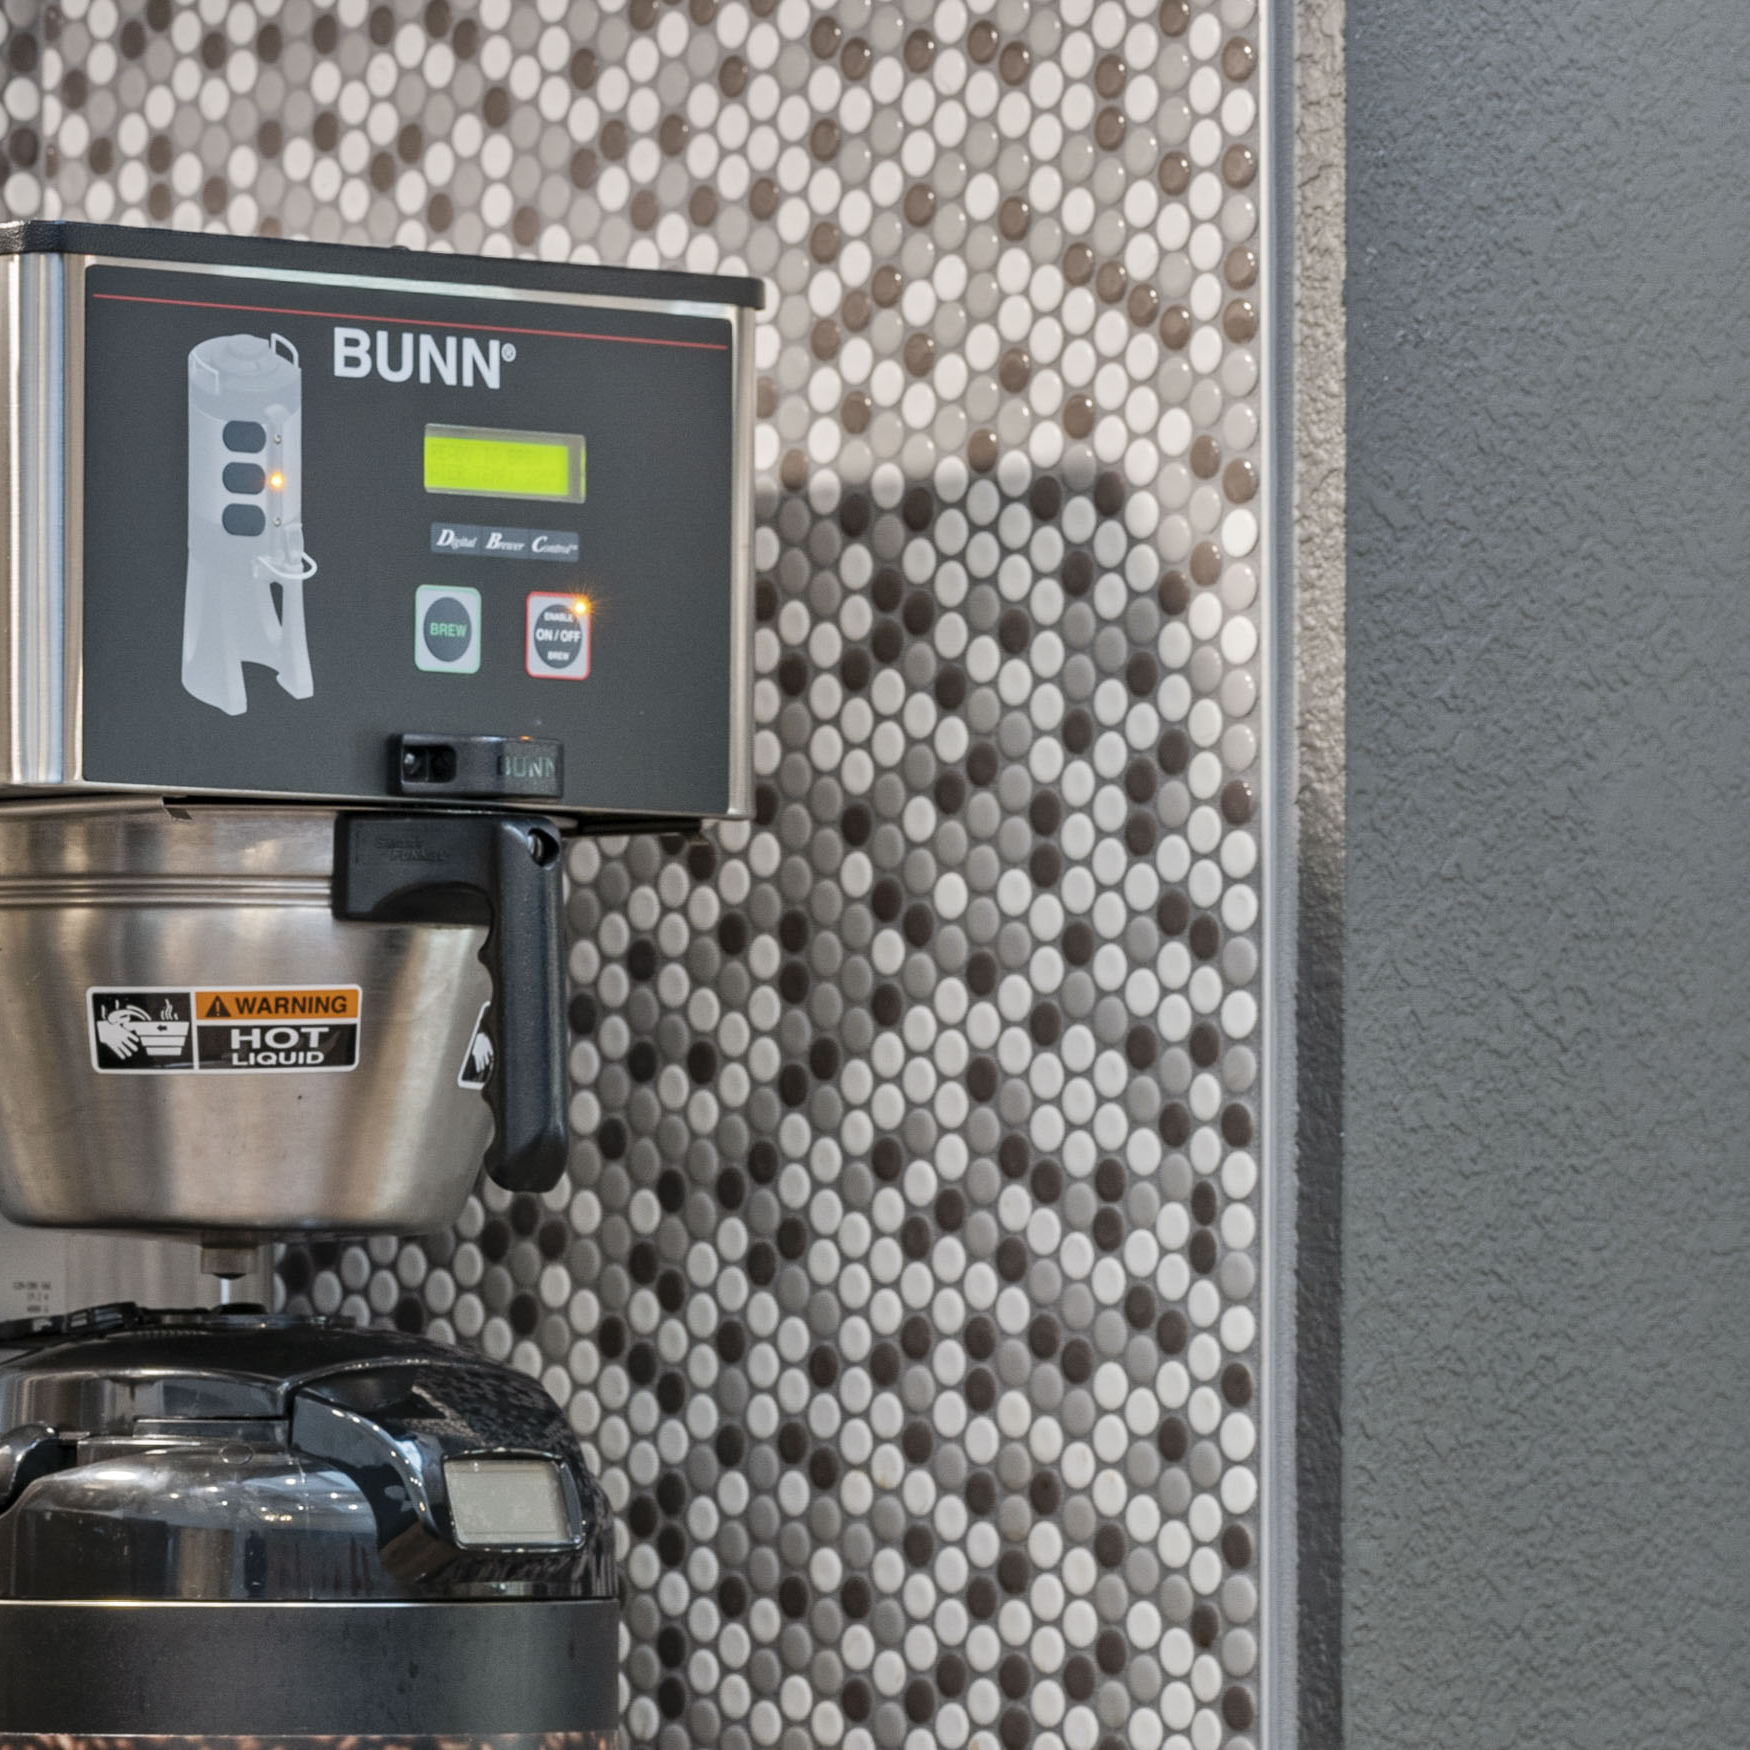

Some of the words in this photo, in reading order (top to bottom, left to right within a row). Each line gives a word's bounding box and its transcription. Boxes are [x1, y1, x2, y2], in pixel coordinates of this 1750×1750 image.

[429, 621, 468, 639] BREW
[234, 995, 348, 1016] WARNING
[230, 1026, 330, 1050] HOT
[231, 1050, 325, 1067] LIQUID
